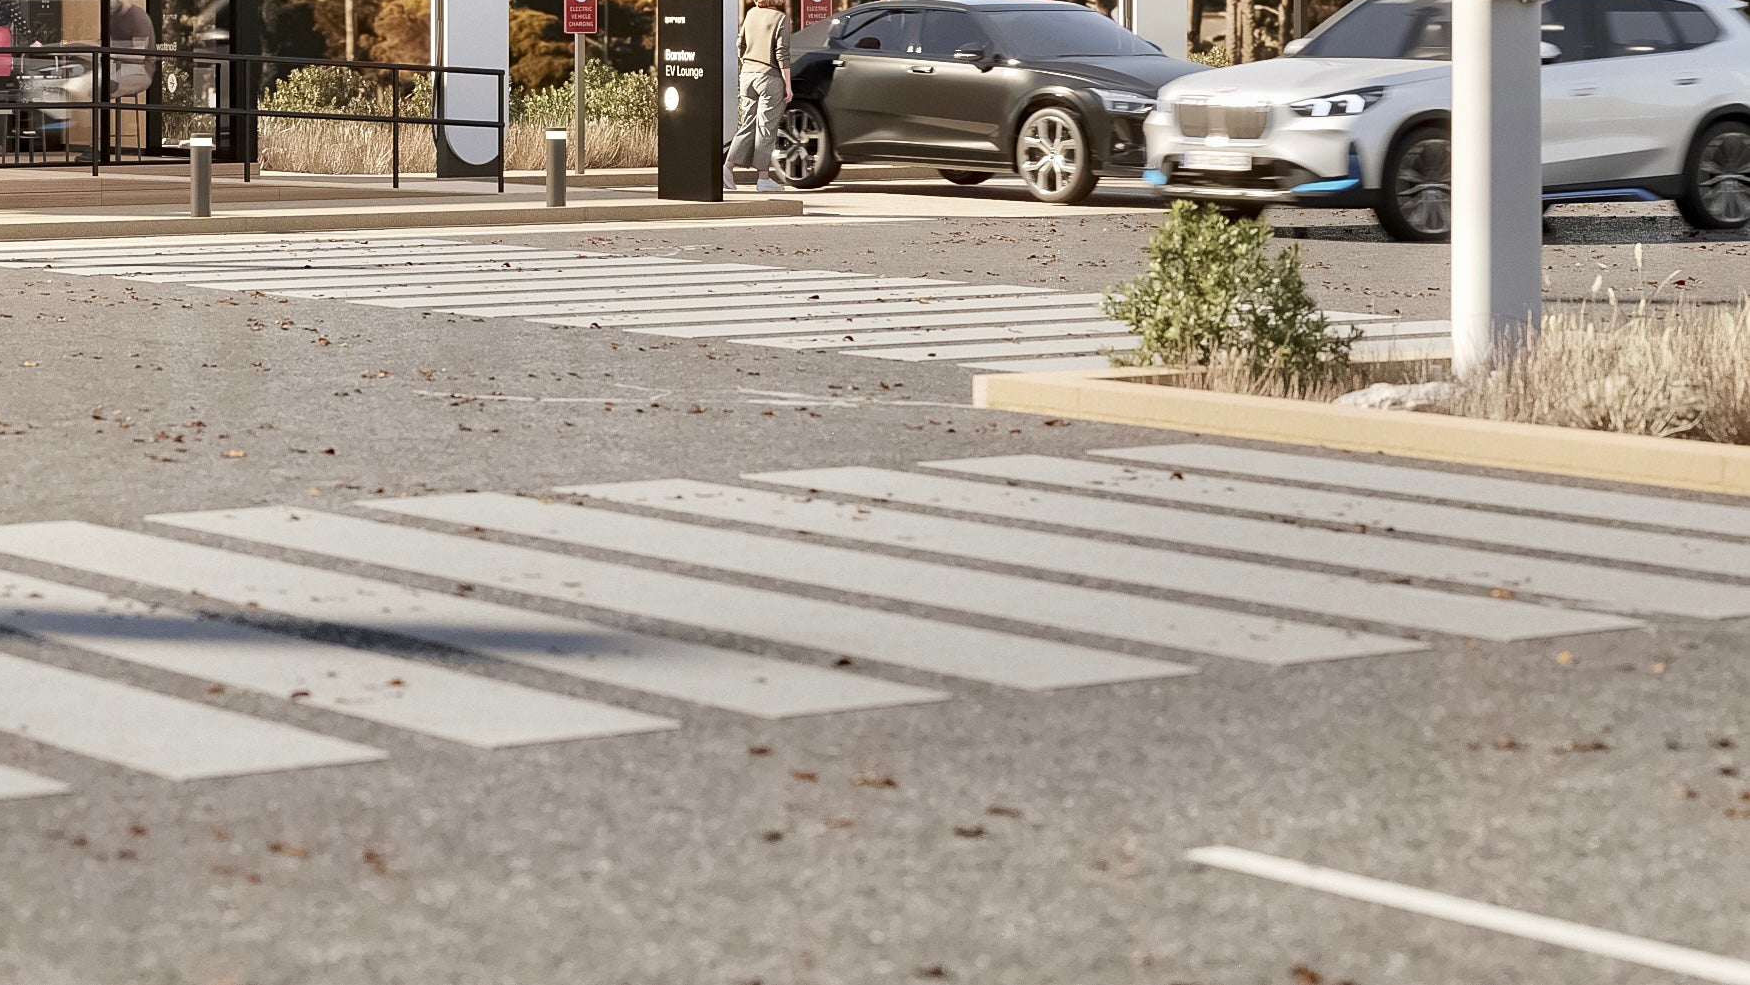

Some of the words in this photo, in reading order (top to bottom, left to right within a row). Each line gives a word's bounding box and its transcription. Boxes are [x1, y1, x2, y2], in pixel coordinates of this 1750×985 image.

[665, 48, 696, 62] Barstow
[665, 65, 676, 76] EV
[676, 65, 704, 80] Lounge
